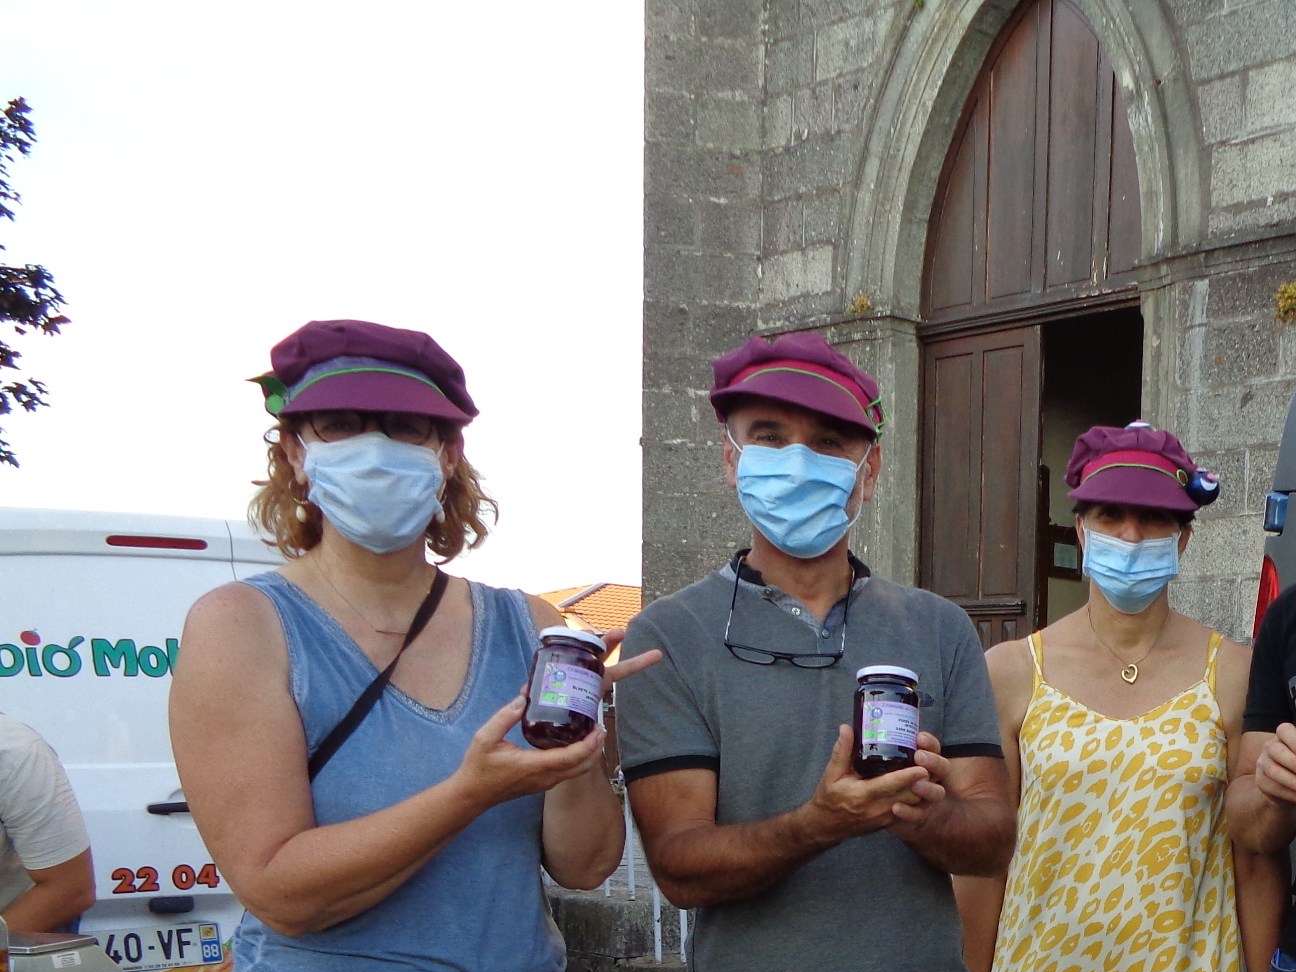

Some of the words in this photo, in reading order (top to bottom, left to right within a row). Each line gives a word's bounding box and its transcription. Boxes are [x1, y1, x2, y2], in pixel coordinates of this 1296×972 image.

[111, 866, 160, 894] 22
[172, 864, 220, 890] 04
[203, 944, 219, 958] 88
